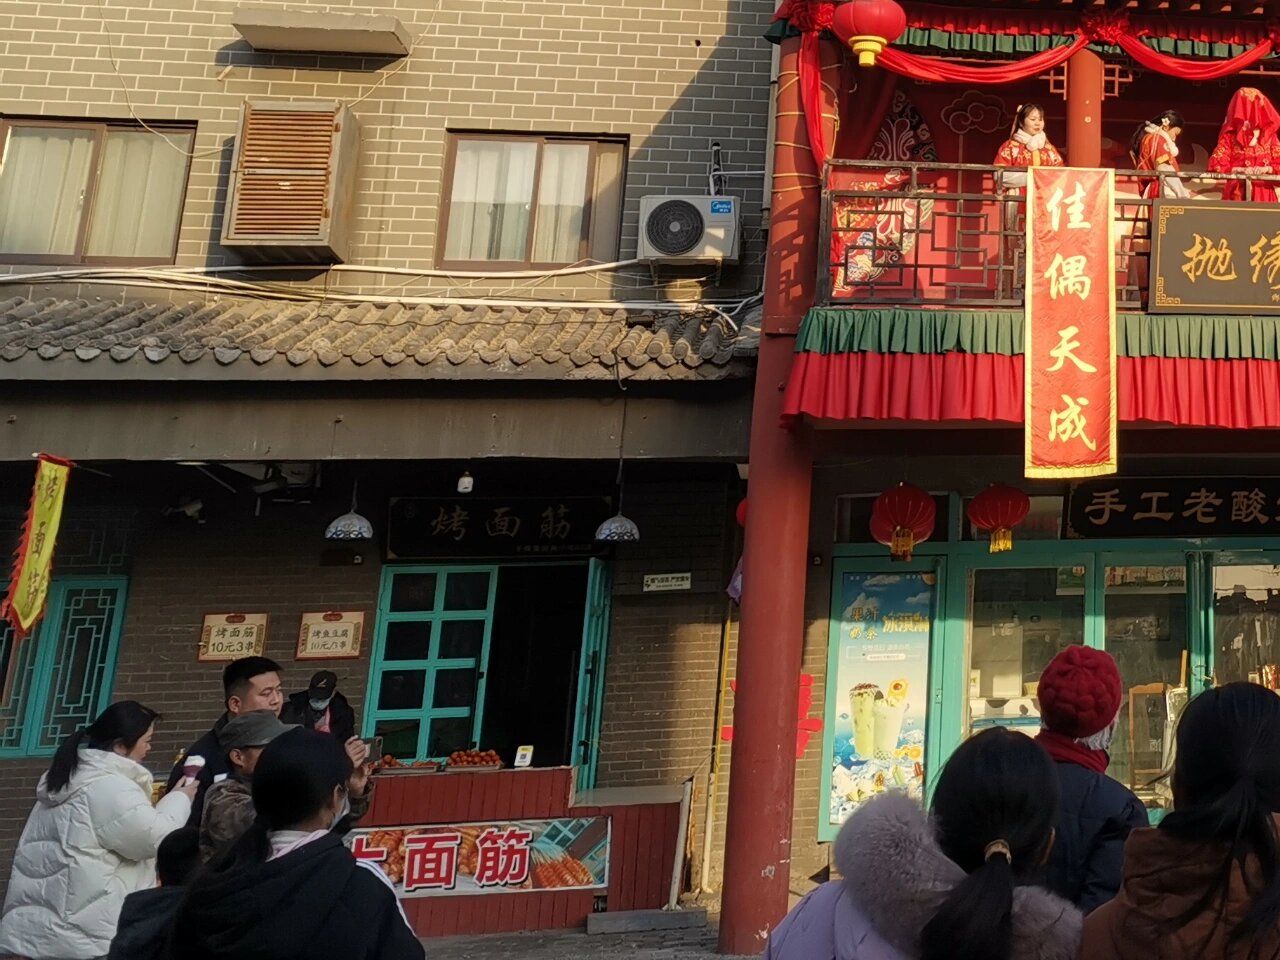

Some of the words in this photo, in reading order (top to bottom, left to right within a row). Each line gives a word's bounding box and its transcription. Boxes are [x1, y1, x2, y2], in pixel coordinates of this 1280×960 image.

[1044, 181, 1098, 452] 佳偶天成
[430, 504, 571, 541] 烤面筋
[214, 626, 254, 638] 烤面筋
